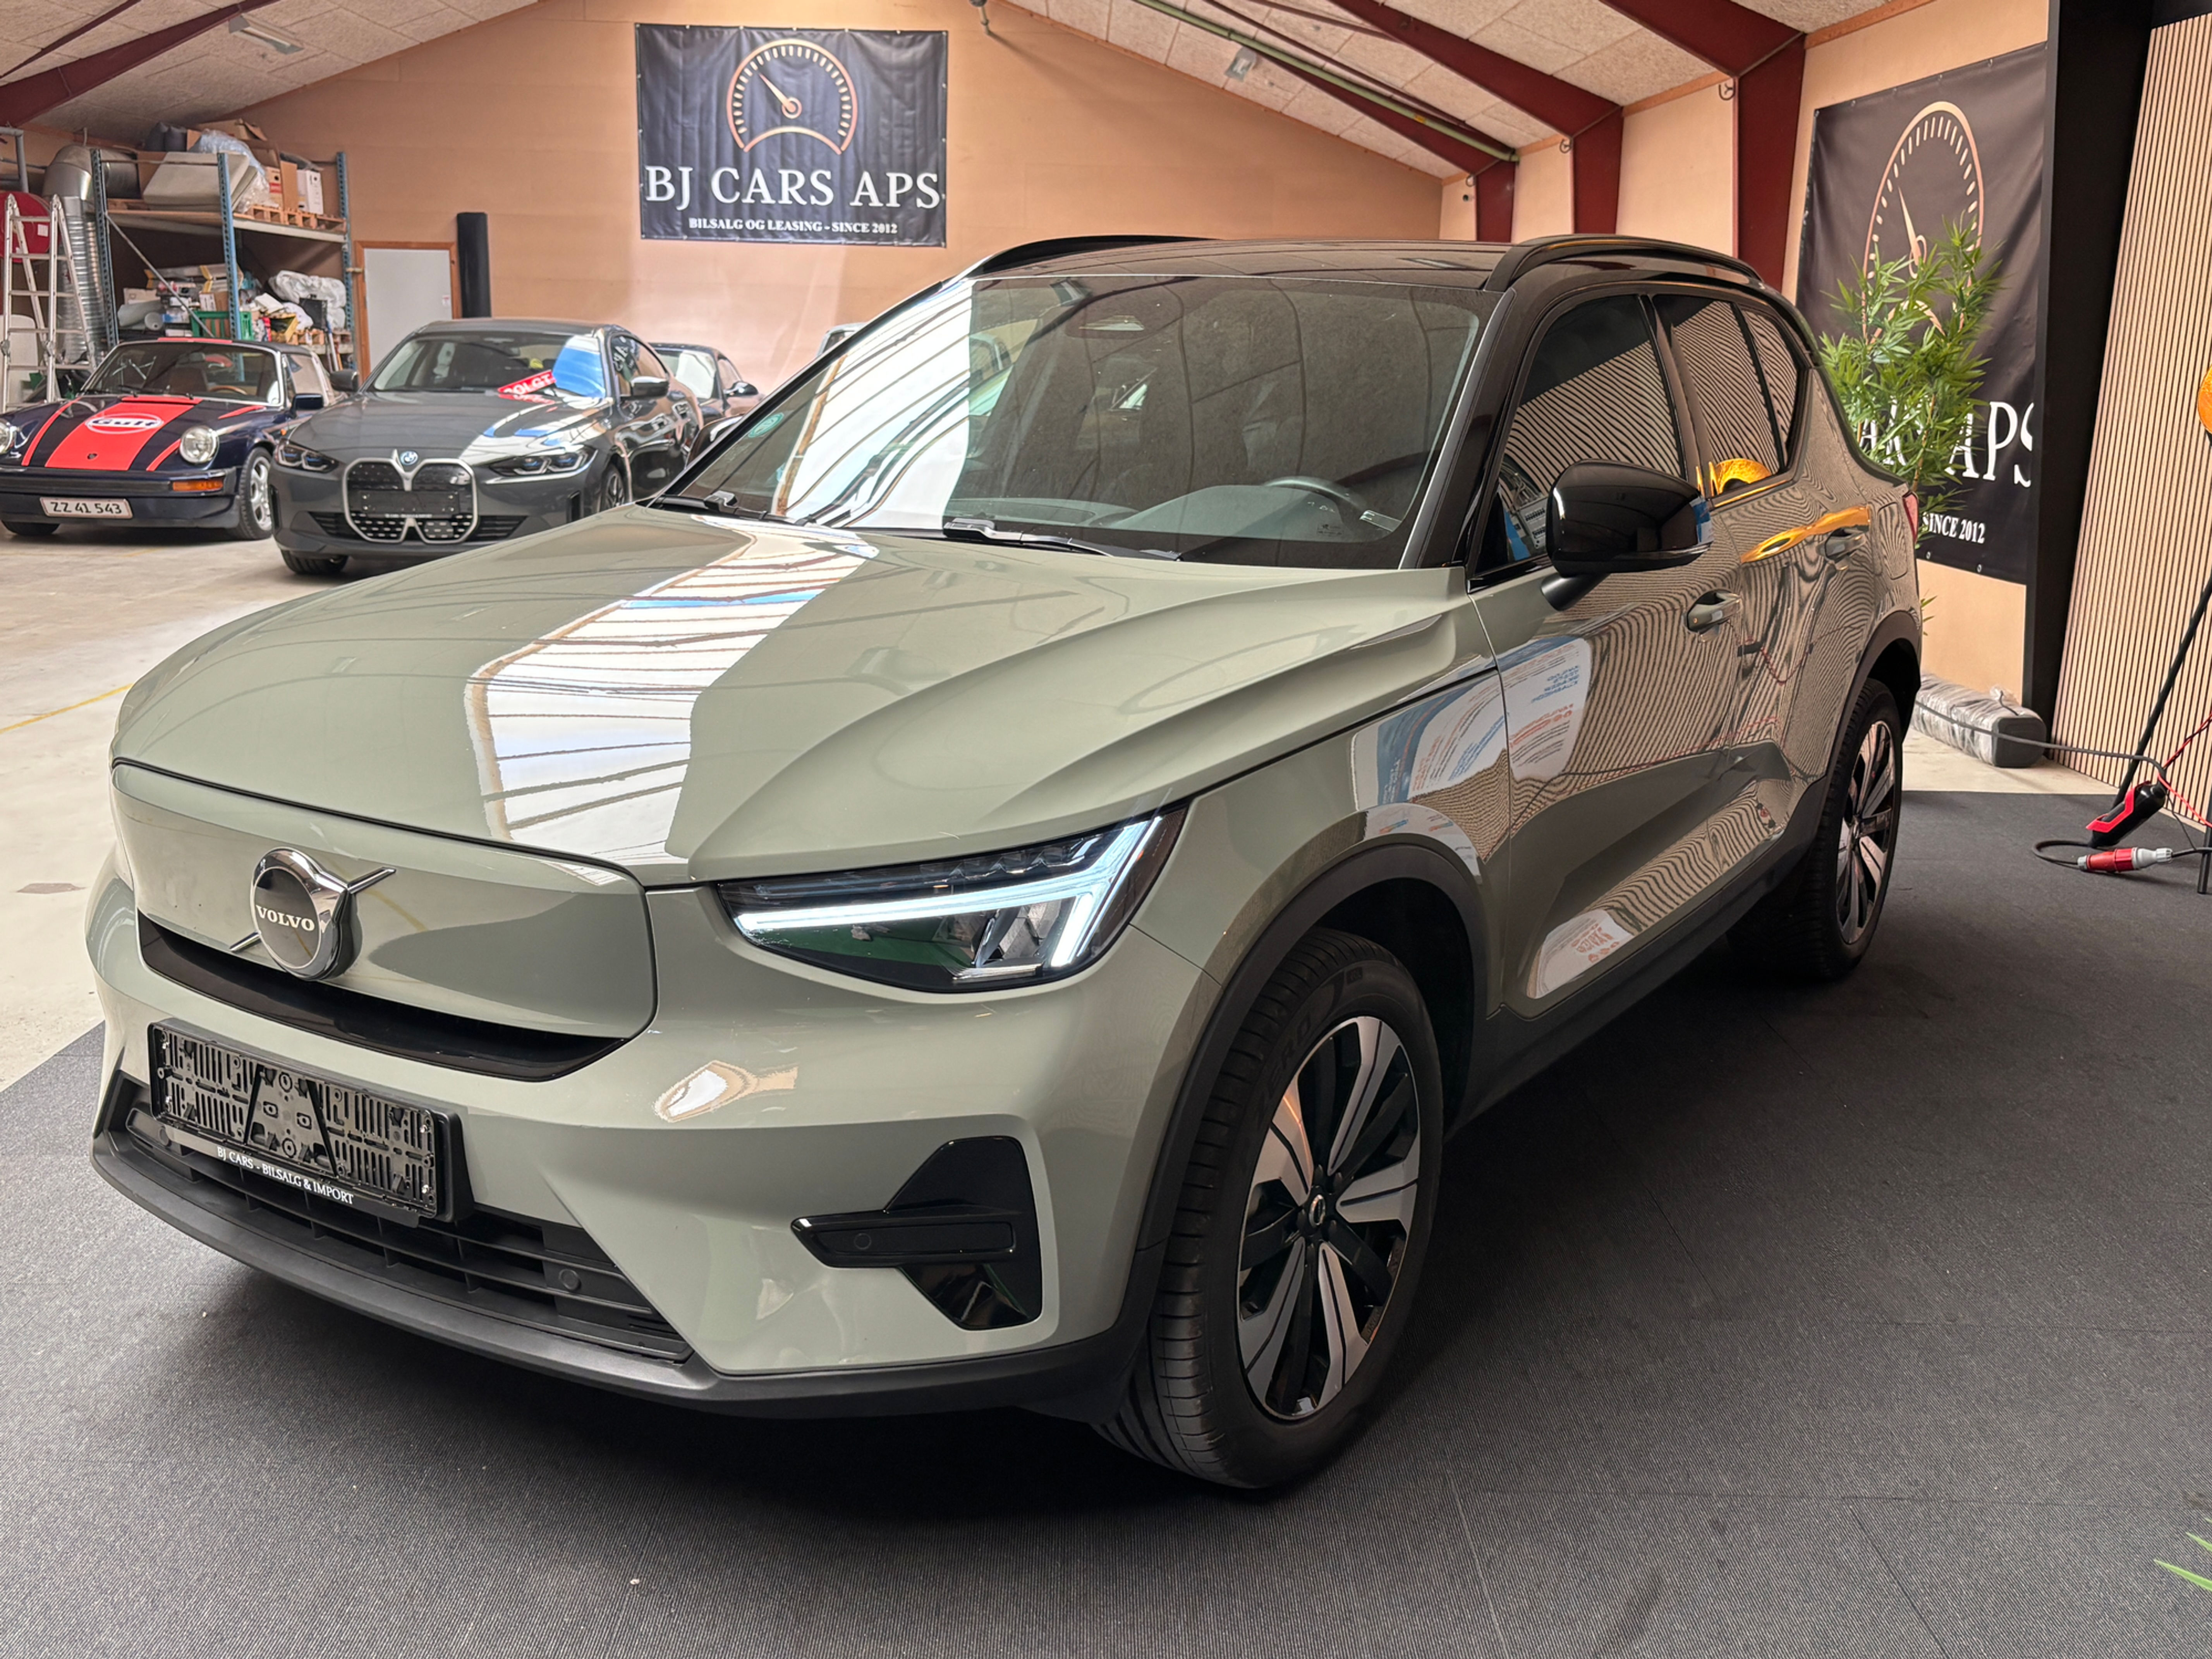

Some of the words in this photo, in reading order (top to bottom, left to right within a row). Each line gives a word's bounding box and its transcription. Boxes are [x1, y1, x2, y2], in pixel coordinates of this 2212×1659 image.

[645, 166, 693, 210] BJ
[711, 167, 833, 206] CARS
[850, 171, 939, 208] APS
[689, 218, 743, 230] BILSALG
[745, 219, 764, 230] OG
[768, 220, 822, 232] LEASING
[832, 222, 870, 233] SINCE
[872, 223, 898, 234] 2012
[50, 502, 71, 513] ZZ
[75, 503, 91, 514] 41
[94, 503, 122, 514] 543
[1923, 512, 1958, 538] SINCE
[1958, 519, 1985, 543] 2012
[256, 905, 315, 931] VOLVO
[217, 1147, 226, 1161] BJ
[229, 1151, 254, 1169] CARS
[262, 1163, 302, 1187] BILSALG
[304, 1178, 311, 1190] &
[313, 1181, 354, 1205] IMPORT
